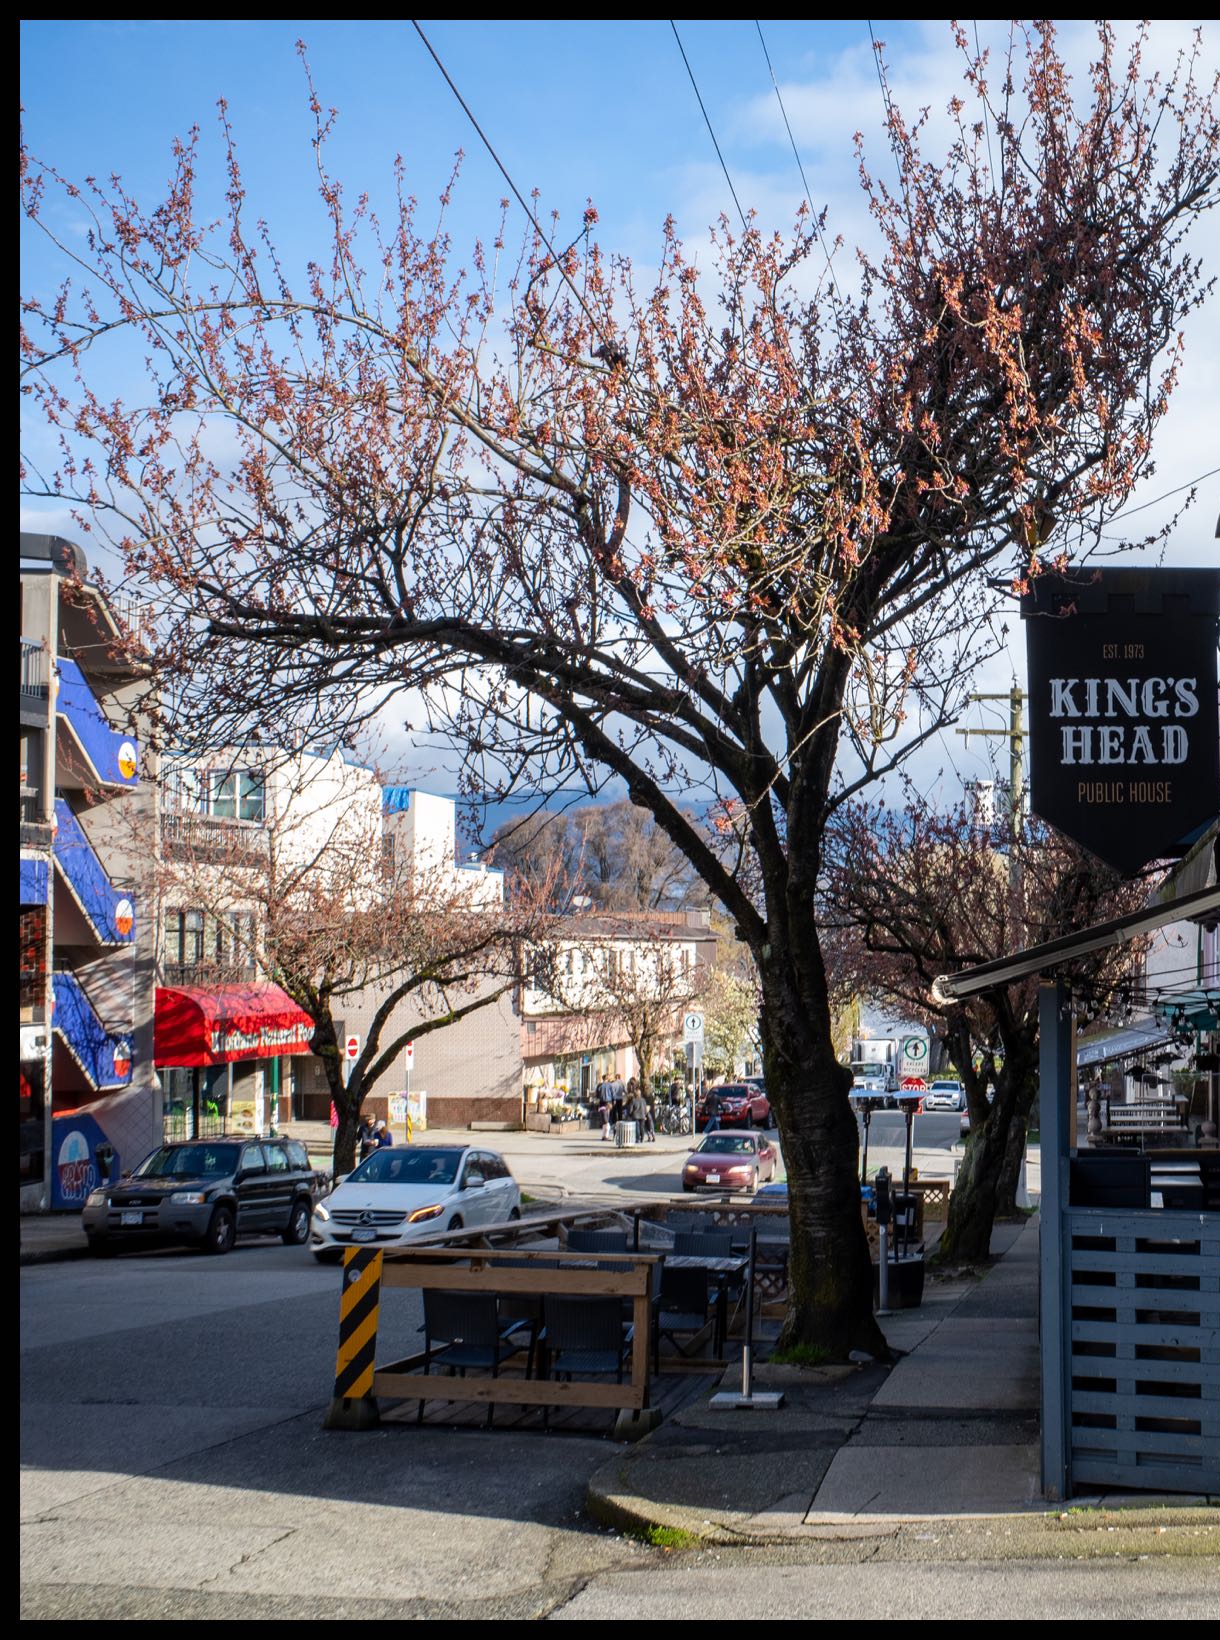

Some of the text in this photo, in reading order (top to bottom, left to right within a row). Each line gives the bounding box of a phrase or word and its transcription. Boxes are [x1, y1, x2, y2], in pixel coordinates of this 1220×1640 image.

[1102, 643, 1145, 659] EST. 1973
[1049, 677, 1200, 718] KING'S
[1060, 724, 1189, 765] HEAD
[1077, 781, 1172, 803] PUBLIC HOUSE
[260, 1025, 297, 1047] Natural
[297, 1022, 315, 1043] Foo
[902, 1084, 926, 1092] STOP
